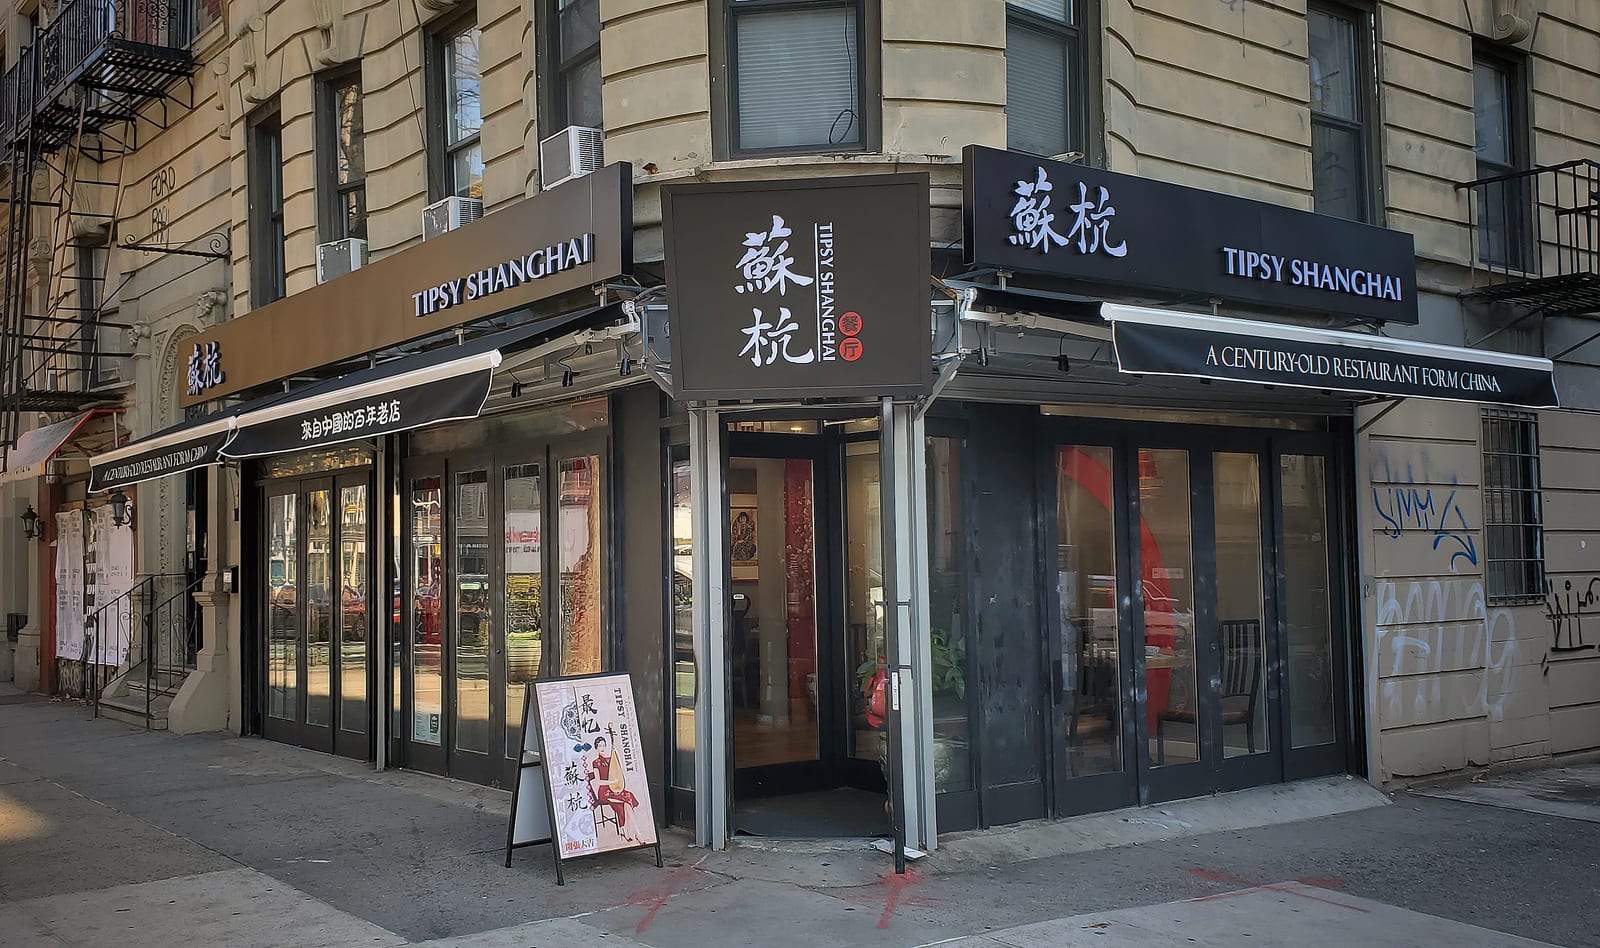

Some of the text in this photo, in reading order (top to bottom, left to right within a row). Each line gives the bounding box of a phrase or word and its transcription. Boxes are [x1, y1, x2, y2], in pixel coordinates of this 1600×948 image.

[1008, 166, 1128, 257] 蘇杭
[412, 233, 593, 316] TIPSY SHANGHAI
[734, 215, 815, 367] 蘇杭
[819, 222, 836, 361] TIPSY SHANGHAI
[1223, 247, 1402, 301] TIPSY SHANGHAI
[186, 341, 223, 396] 蘇杭
[1206, 345, 1502, 393] A CENTURY-OLD RESTAURANT FORM CHINA
[301, 399, 401, 441] 來自中國的百年老店
[579, 694, 601, 734] 最忆
[614, 687, 626, 718] TIPSY
[619, 723, 634, 772] SHANGHAI
[564, 761, 588, 812] 蘇杭
